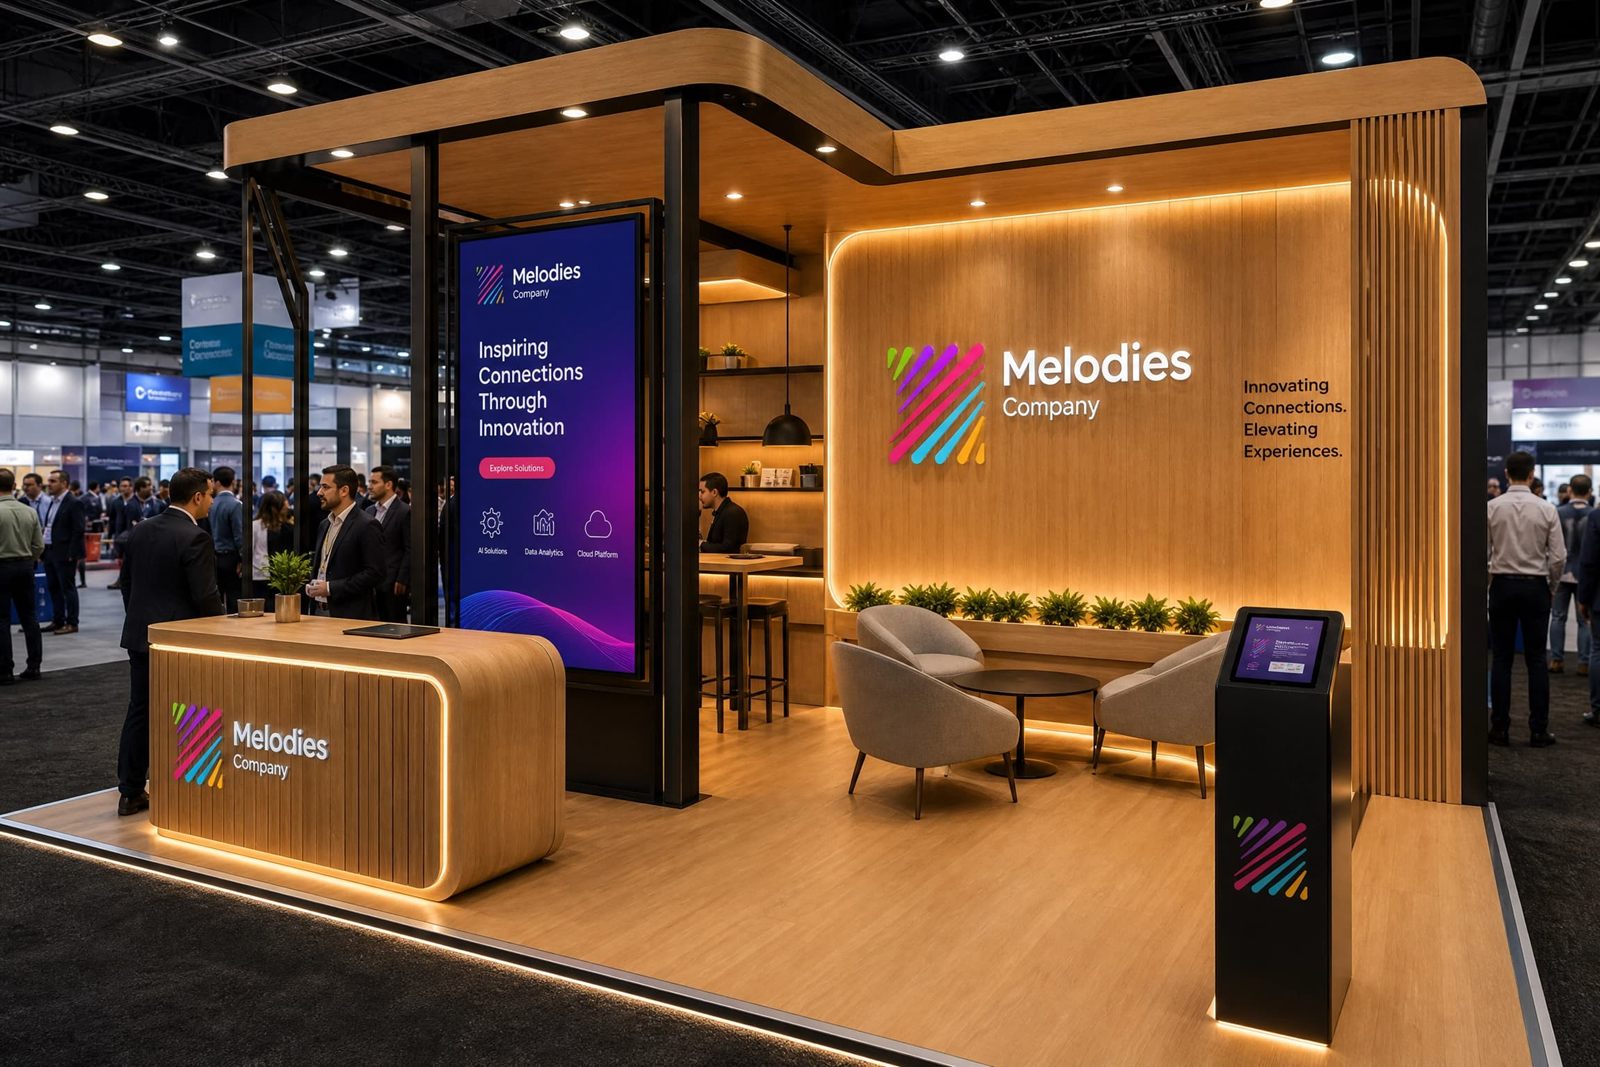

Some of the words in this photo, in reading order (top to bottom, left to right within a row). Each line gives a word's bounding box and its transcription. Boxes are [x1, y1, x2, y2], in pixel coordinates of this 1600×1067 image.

[512, 262, 581, 286] Melodies
[512, 288, 550, 300] Company
[479, 338, 549, 362] Inspiring
[1003, 341, 1192, 387] Melodies
[478, 363, 584, 385] Connections
[1244, 378, 1329, 395] Innovating
[478, 390, 548, 413] Through
[1002, 397, 1100, 421] Company
[1244, 400, 1347, 415] Connections.
[479, 417, 565, 437] Innovation
[1244, 422, 1318, 439] Elevating
[1244, 444, 1343, 461] Experiences.
[489, 464, 513, 475] Explore
[514, 463, 544, 473] Solutions
[484, 547, 508, 555] Solutions
[524, 548, 538, 556] Data
[538, 548, 564, 558] Analytics
[577, 549, 594, 558] Cloud
[594, 550, 619, 559] Platform
[233, 721, 329, 760] Melodies
[233, 754, 288, 780] Company
